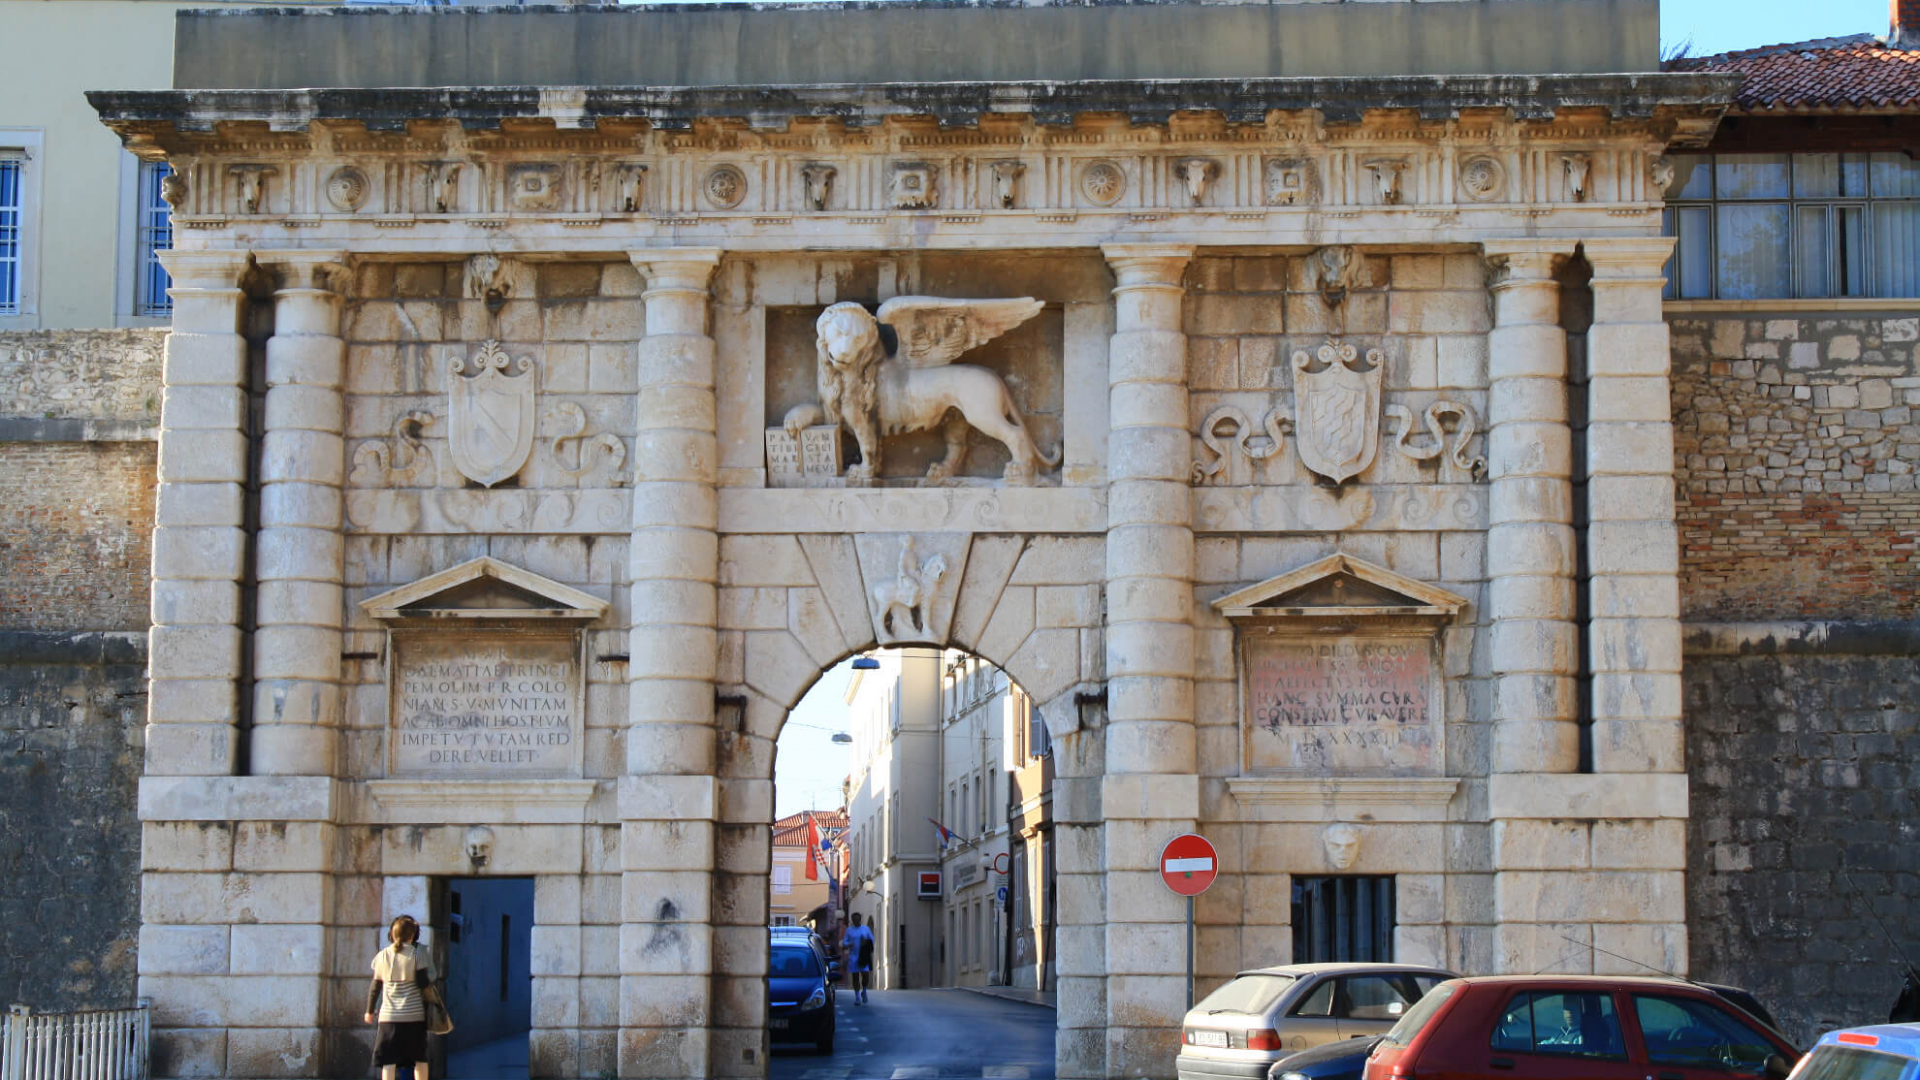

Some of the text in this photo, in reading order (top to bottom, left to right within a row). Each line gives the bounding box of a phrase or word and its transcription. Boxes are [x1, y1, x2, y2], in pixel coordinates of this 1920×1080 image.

[403, 664, 501, 678] DALMATIAE
[404, 681, 434, 694] PEM
[438, 681, 481, 694] OLIM
[403, 698, 445, 712] NIAM
[536, 732, 570, 746] RED
[428, 749, 473, 763] DERE
